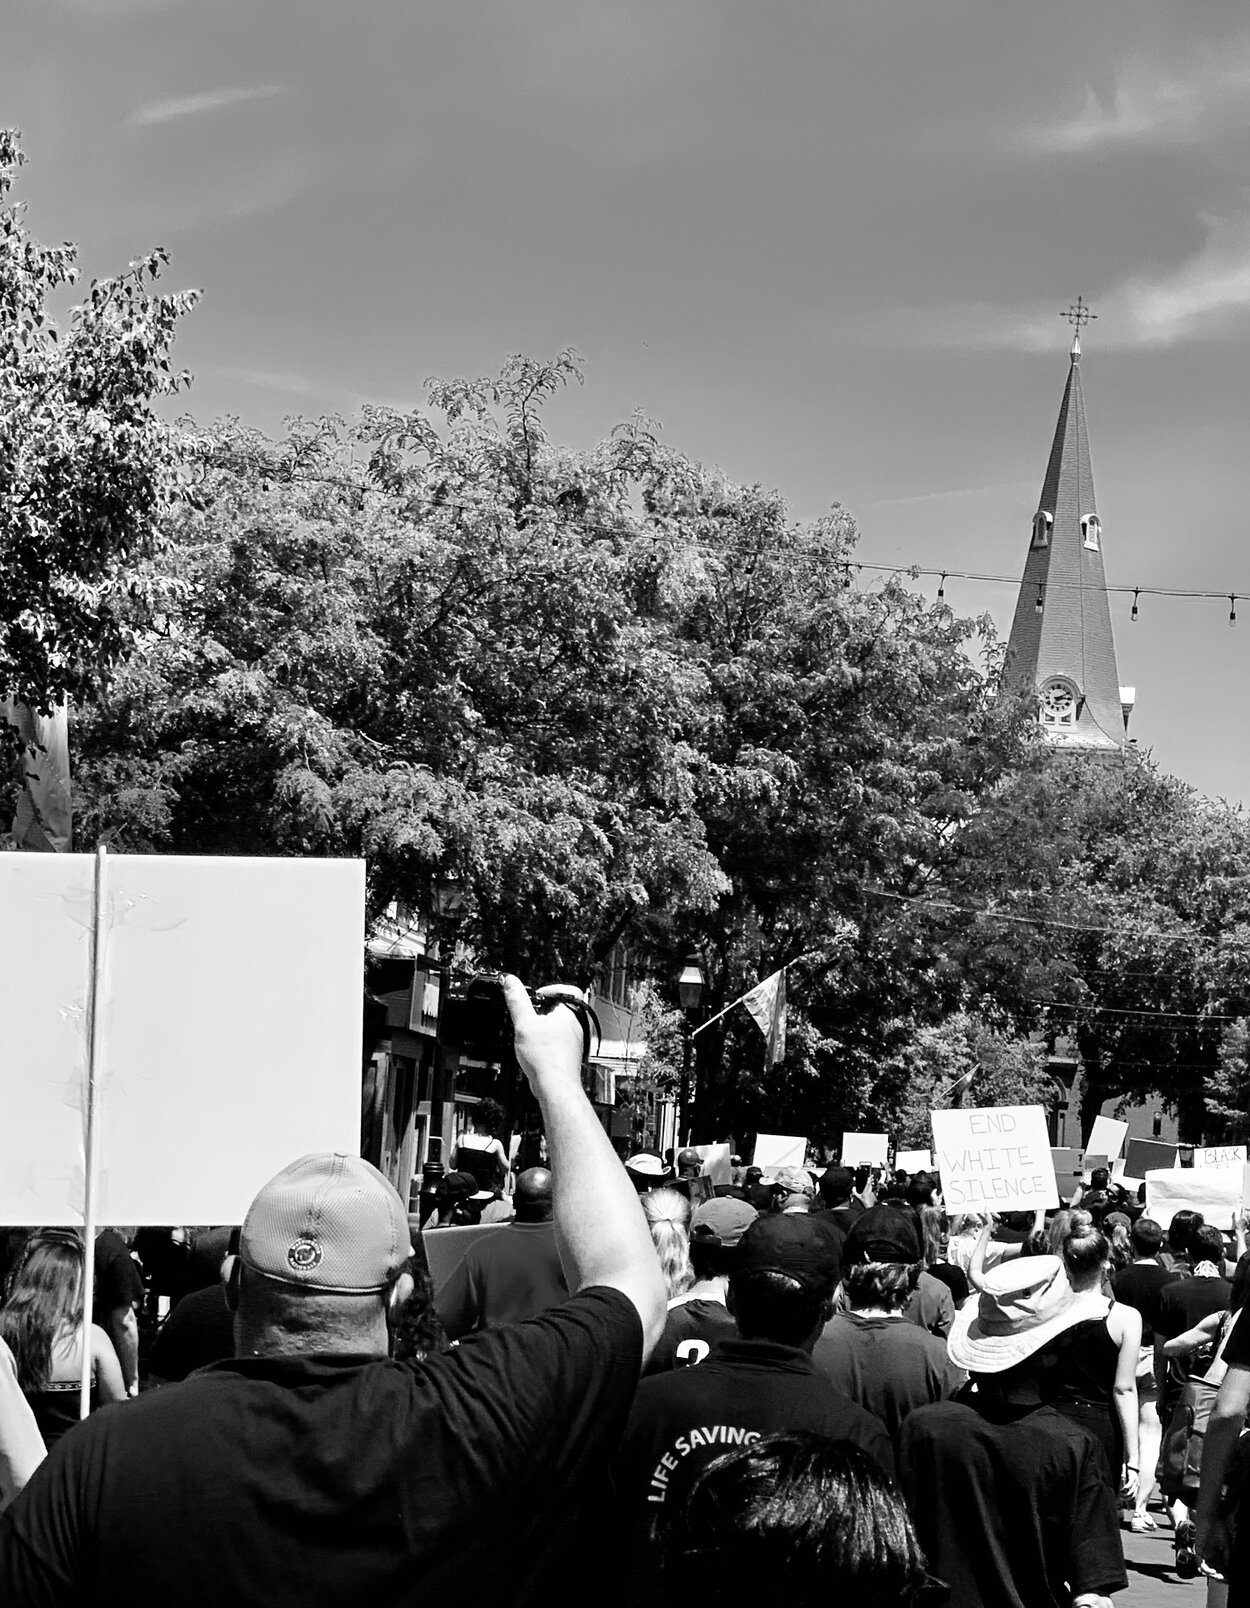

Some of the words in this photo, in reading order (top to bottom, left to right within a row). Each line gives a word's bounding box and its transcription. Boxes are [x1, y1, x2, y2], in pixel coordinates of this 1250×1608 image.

[969, 1113, 1017, 1135] END
[943, 1145, 1034, 1173] WHITE
[949, 1175, 1047, 1205] SILENCE
[647, 1452, 679, 1502] LIFE
[675, 1425, 762, 1457] SAVING
